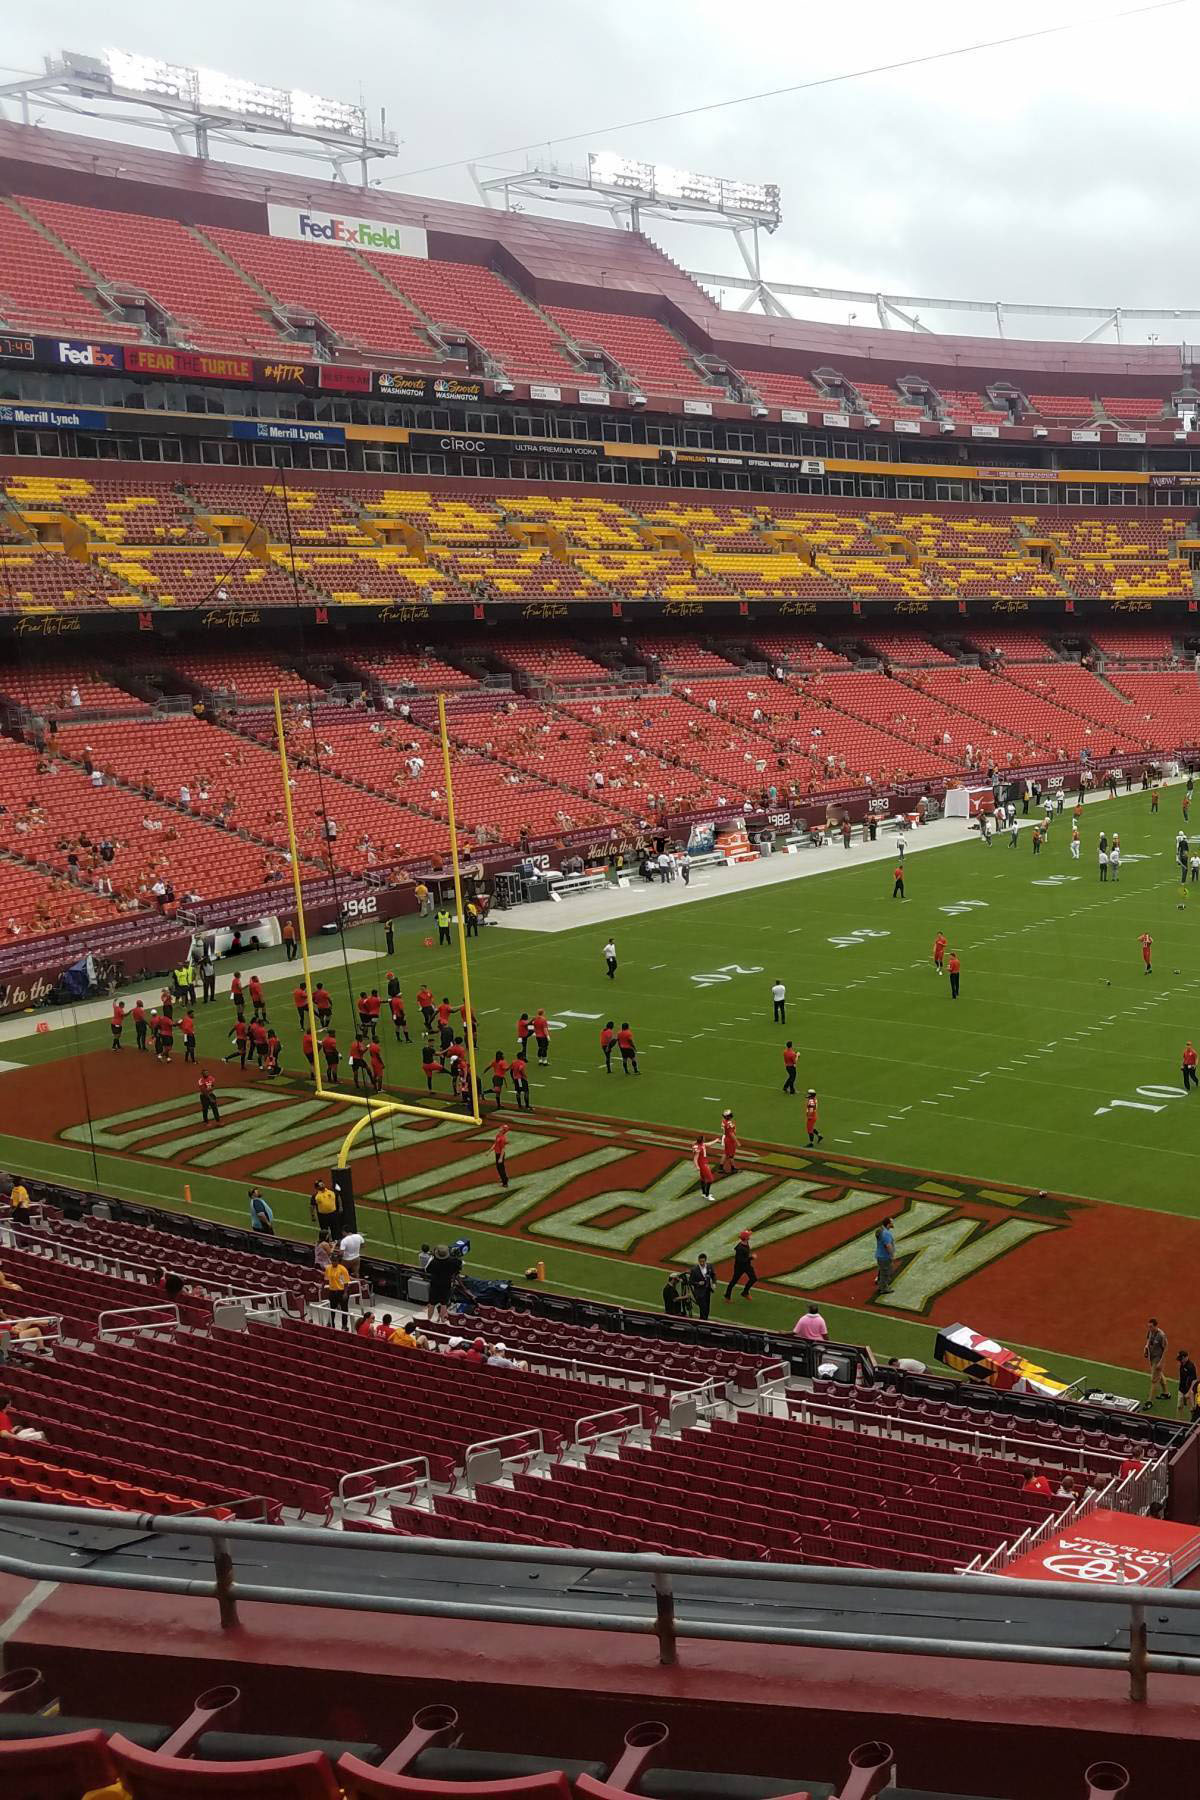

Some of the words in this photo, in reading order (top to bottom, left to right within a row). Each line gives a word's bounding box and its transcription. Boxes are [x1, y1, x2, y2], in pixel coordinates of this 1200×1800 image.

[299, 214, 401, 251] FedExField
[0, 341, 33, 356] 7:49
[59, 342, 116, 367] FedEx
[394, 373, 426, 390] Sports
[448, 379, 479, 396] Sports
[15, 410, 49, 424] Merrill
[51, 412, 80, 427] Lynch
[270, 427, 298, 439] Merrill
[299, 428, 324, 441] Lynch
[515, 444, 538, 453] ULTRA
[539, 446, 573, 455] PREMIUM
[574, 447, 598, 457] VODKA
[767, 813, 791, 827] 1982
[588, 841, 609, 860] Hail
[608, 844, 618, 856] to
[619, 838, 633, 855] the
[342, 896, 377, 918] 1942
[827, 929, 892, 945] 30
[690, 964, 766, 984] 20
[12, 987, 28, 1005] to
[30, 977, 53, 1000] the
[1110, 1085, 1189, 1113] 10
[1073, 1535, 1106, 1549] Places
